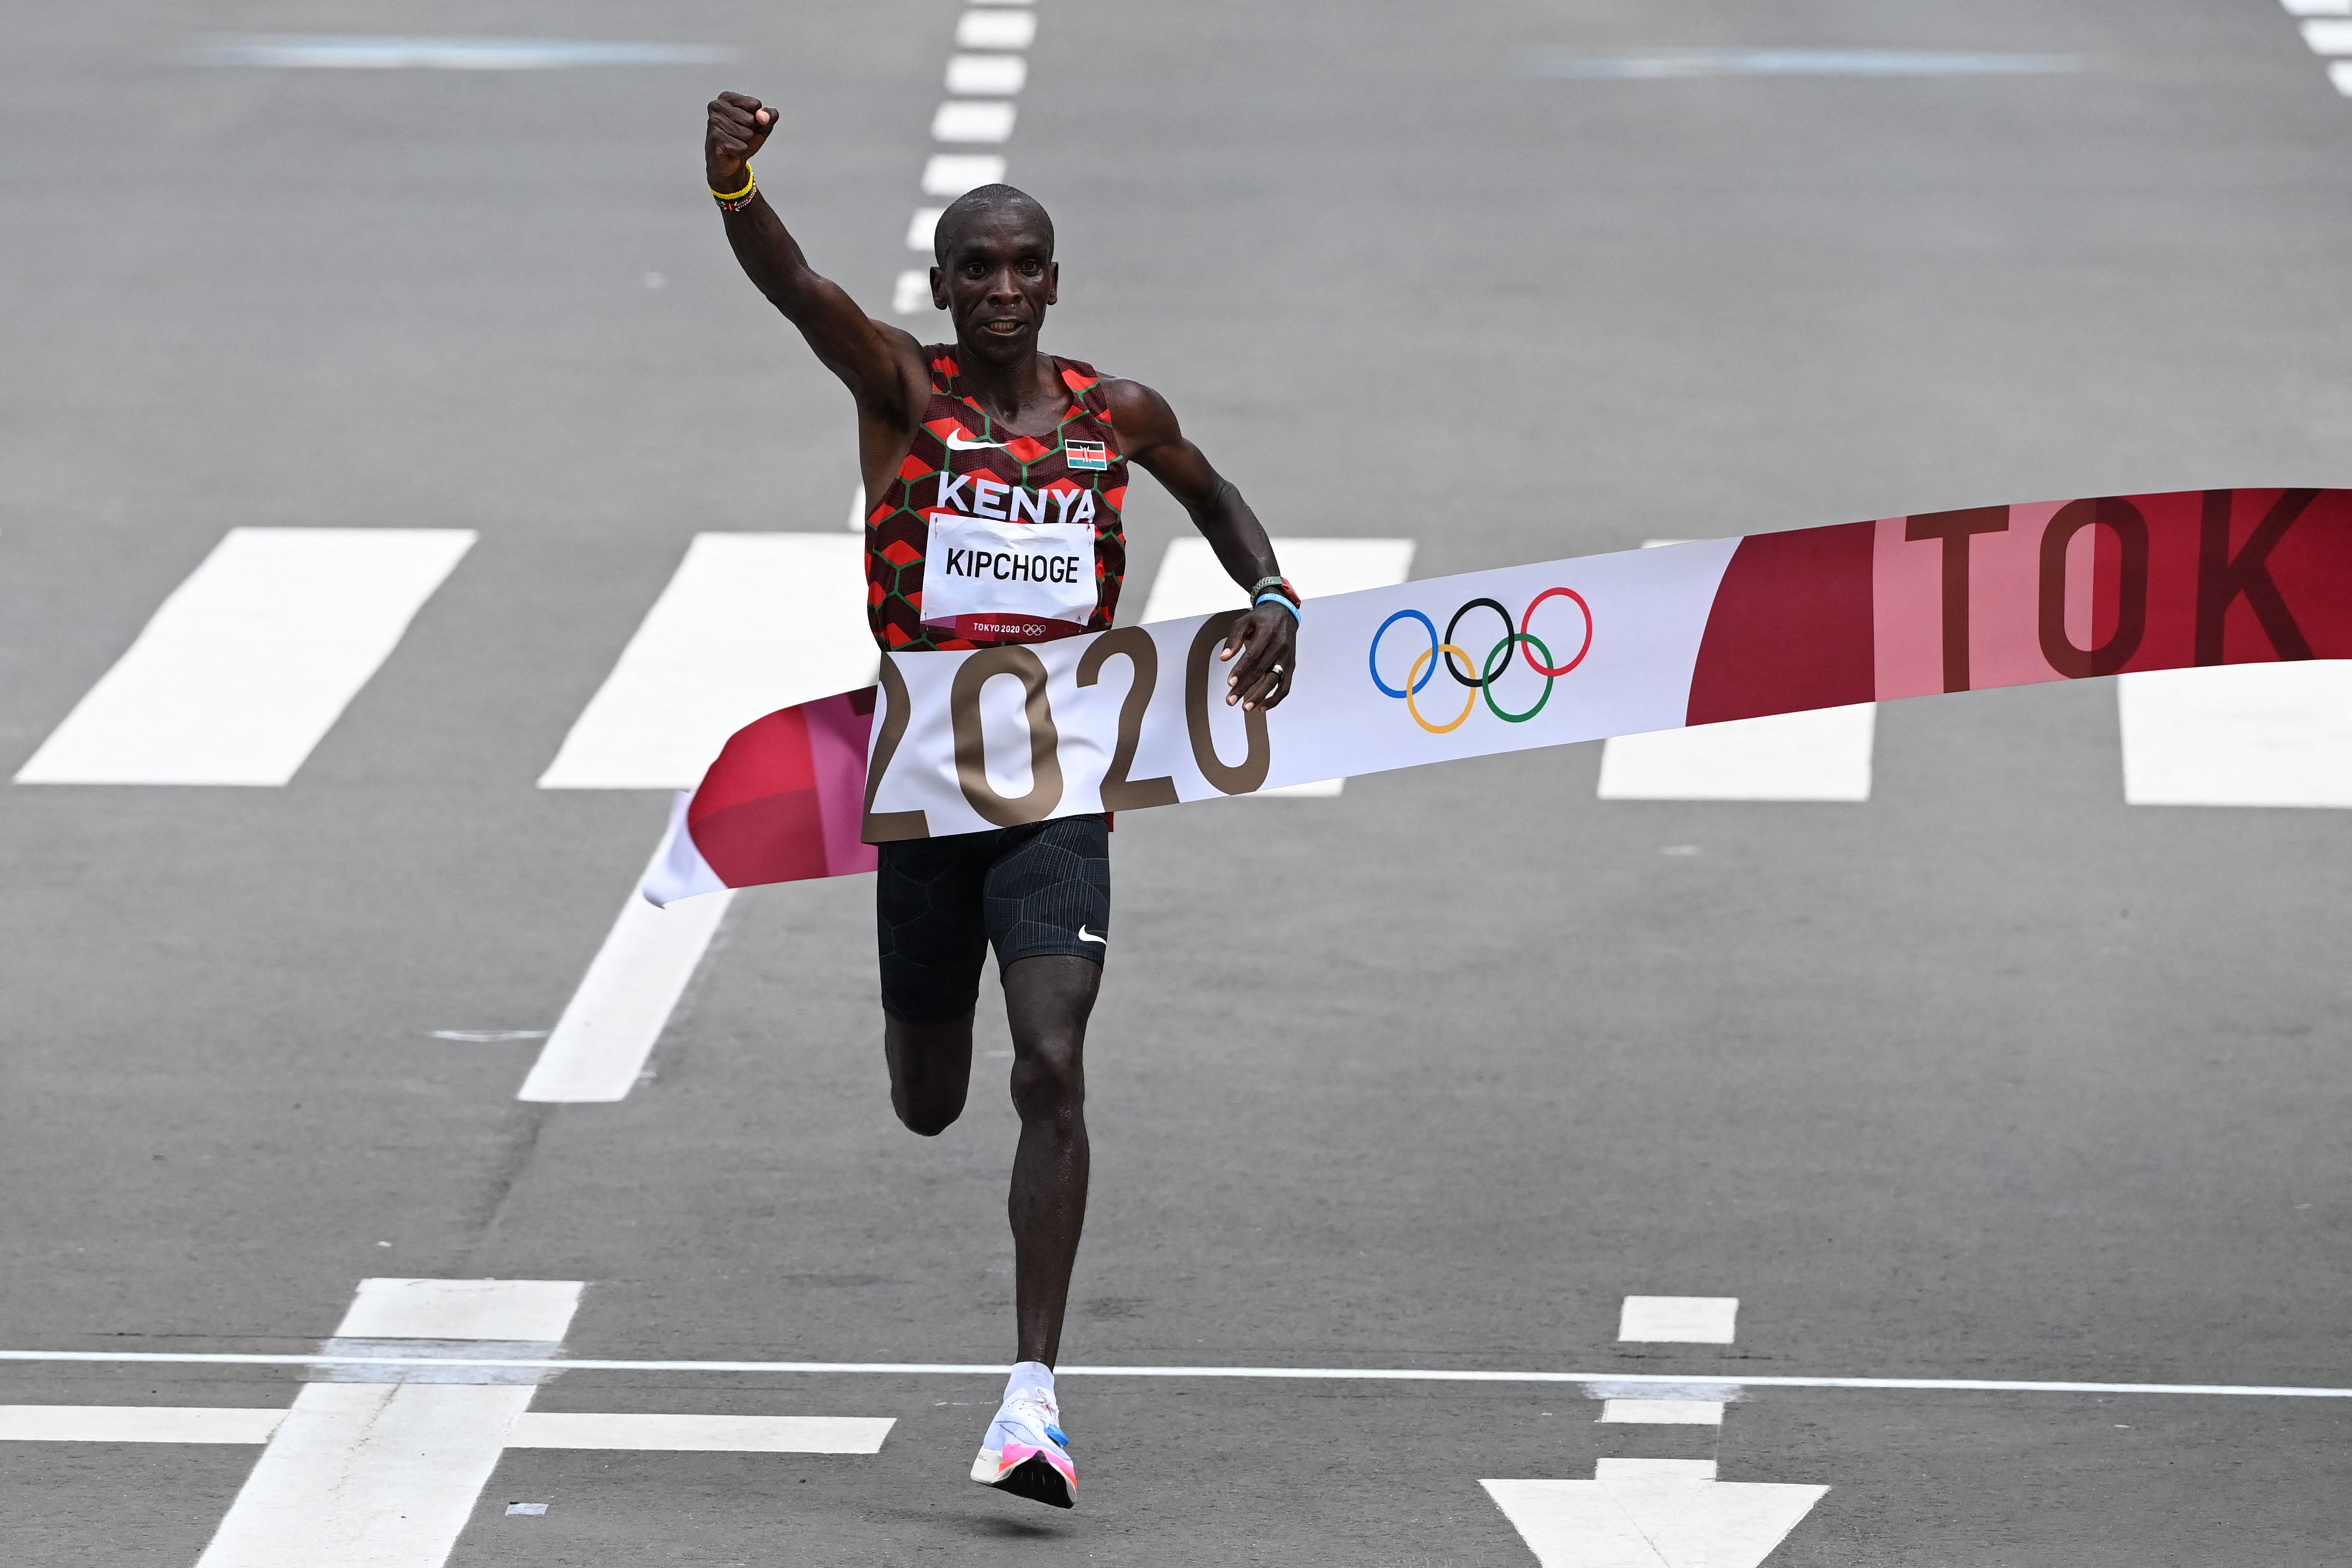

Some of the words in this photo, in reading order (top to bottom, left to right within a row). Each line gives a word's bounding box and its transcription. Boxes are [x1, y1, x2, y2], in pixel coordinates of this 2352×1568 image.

[936, 471, 1095, 524] KENYA
[945, 547, 1079, 584] KIPCHOGE
[1905, 488, 2323, 694] TOK
[973, 623, 1000, 632] TOKYO
[1001, 625, 1020, 634] 2020
